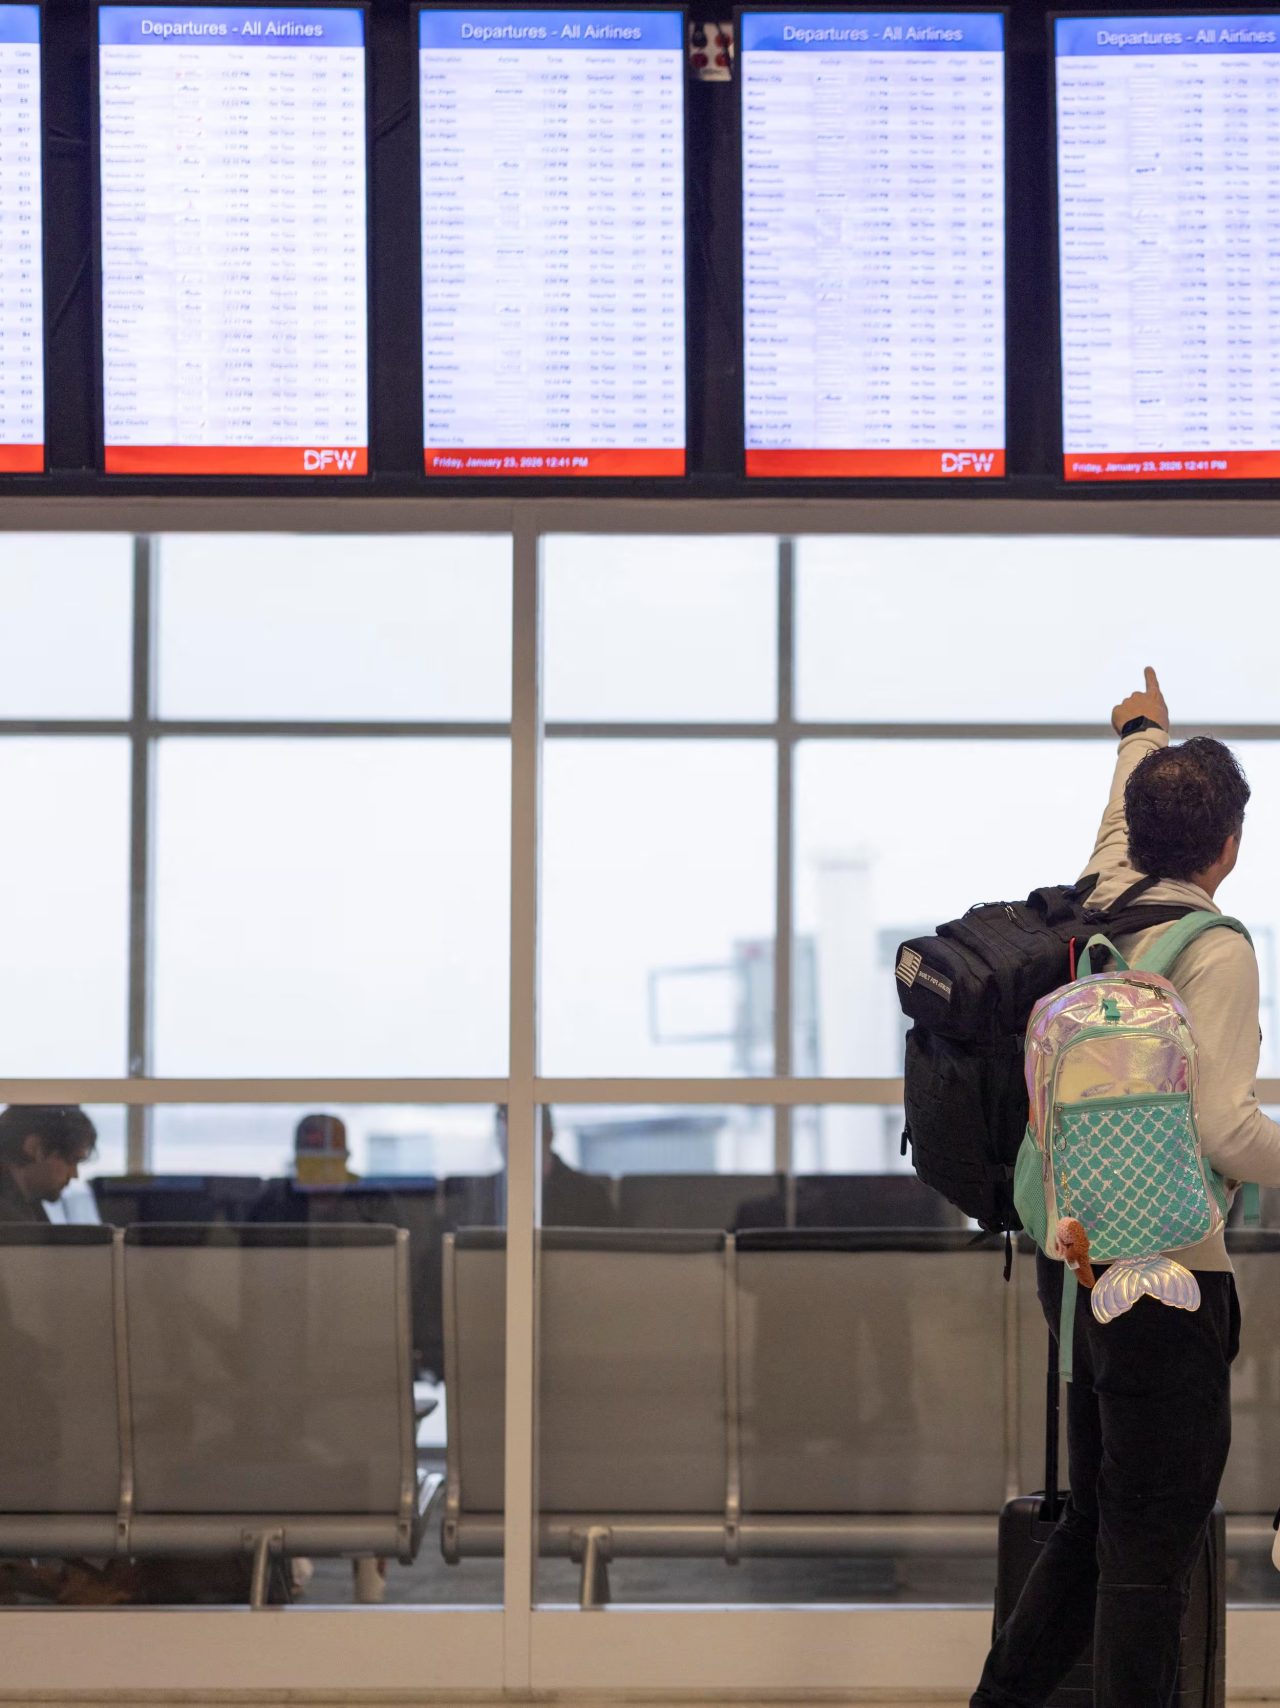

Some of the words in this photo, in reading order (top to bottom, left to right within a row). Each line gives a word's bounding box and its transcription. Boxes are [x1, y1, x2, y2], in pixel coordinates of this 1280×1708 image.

[141, 20, 227, 38] Departures
[241, 21, 261, 36] All
[265, 21, 323, 37] Airlines
[461, 23, 547, 41] Departures
[561, 24, 580, 39] All
[584, 24, 642, 40] Airlines
[783, 25, 869, 43] Departures
[882, 26, 902, 41] All
[906, 26, 963, 42] Airlines
[1096, 30, 1183, 48] Departures
[1195, 29, 1216, 44] All
[1219, 28, 1277, 44] Airlines
[303, 449, 357, 471] DFW
[433, 457, 463, 469] Friday,
[466, 457, 502, 469] January
[520, 457, 543, 467] 2026
[546, 457, 570, 467] 12:41
[572, 457, 588, 467] PM
[941, 452, 995, 473] DFW
[1105, 462, 1141, 473] January
[1210, 460, 1227, 470] PM
